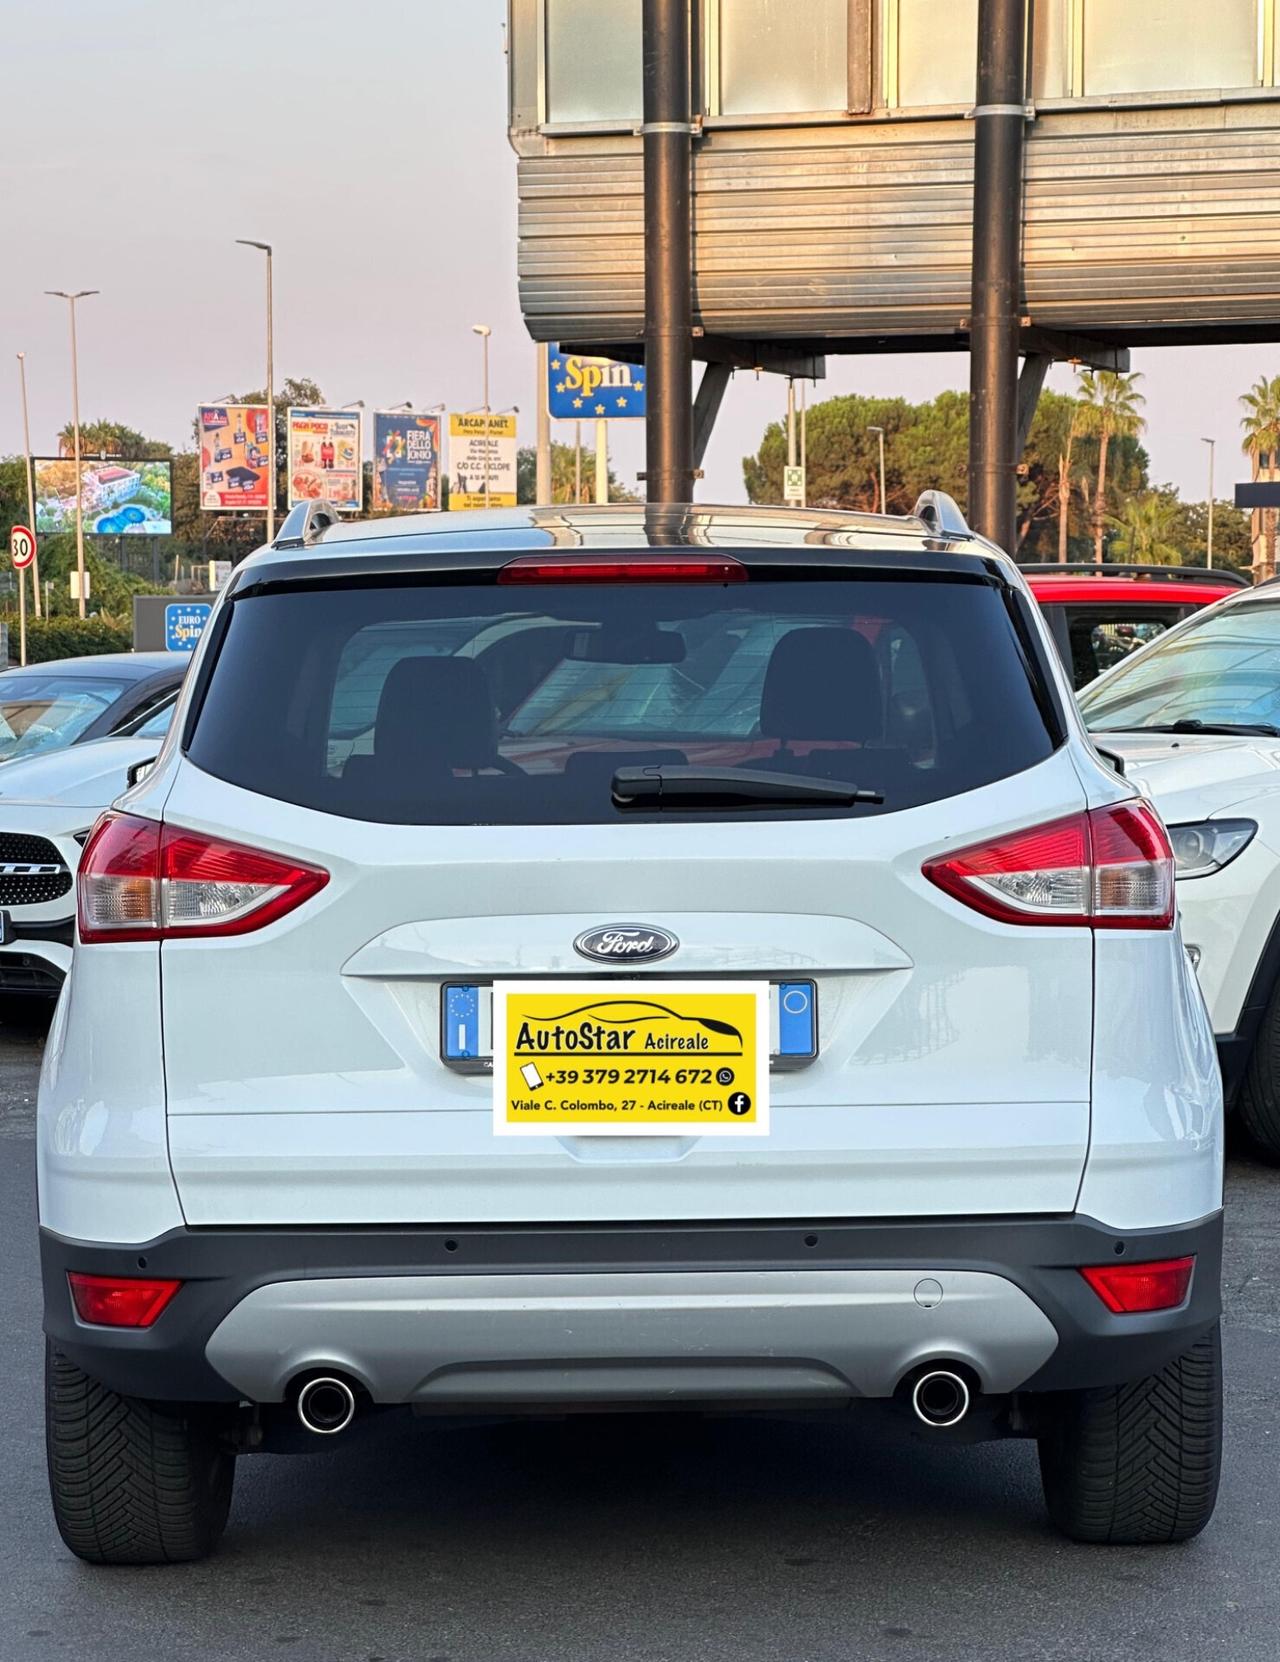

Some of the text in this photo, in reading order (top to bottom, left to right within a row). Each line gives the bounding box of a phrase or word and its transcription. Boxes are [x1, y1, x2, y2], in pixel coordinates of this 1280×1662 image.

[565, 356, 633, 397] Spin
[457, 418, 509, 428] ARCAPANET
[407, 430, 431, 440] FIERA
[407, 440, 431, 449] DELLO
[13, 538, 28, 557] 30
[178, 615, 201, 625] EURO
[175, 624, 202, 642] Spin
[596, 930, 655, 954] Ford
